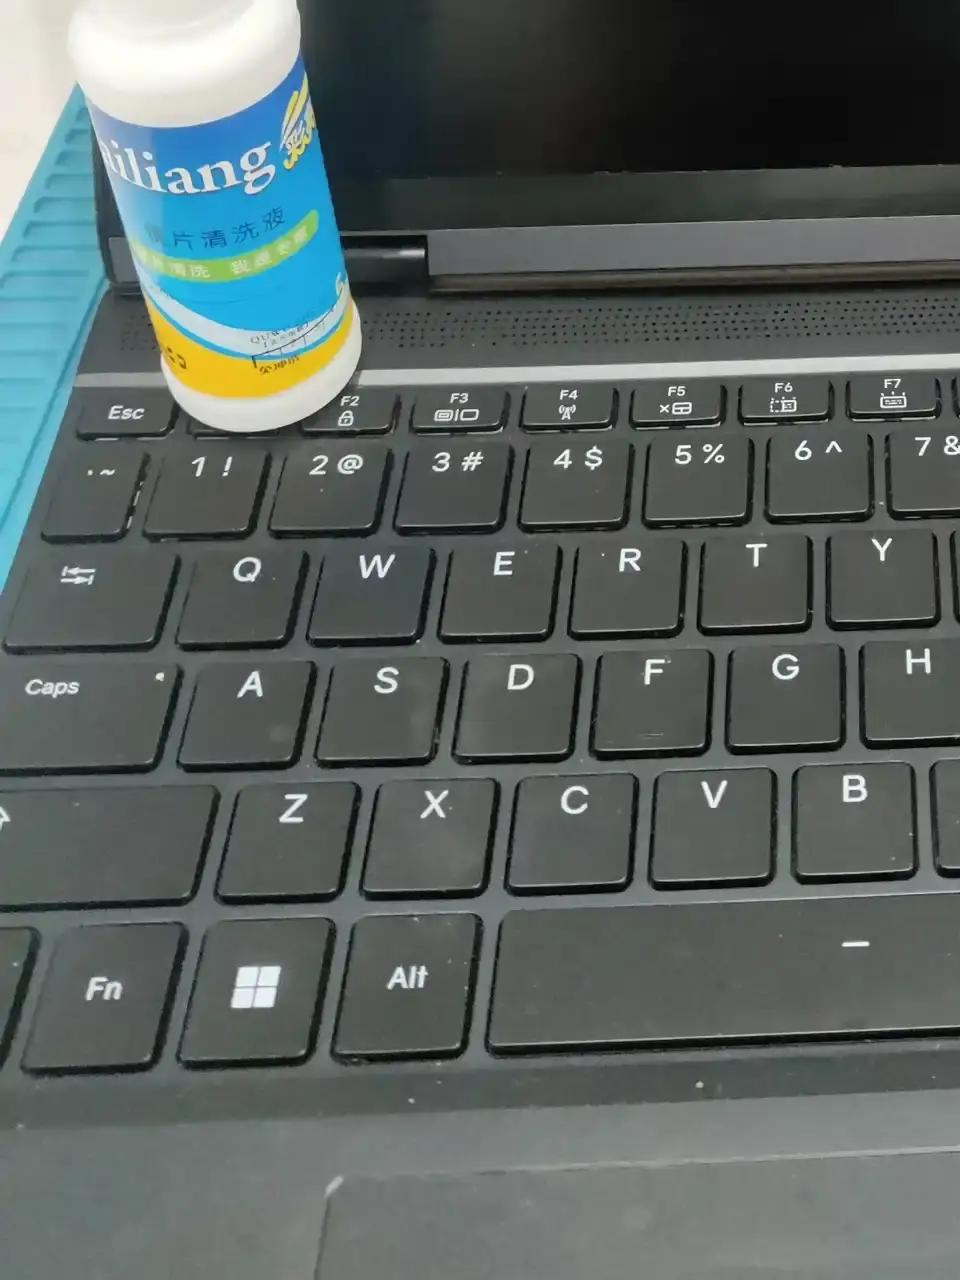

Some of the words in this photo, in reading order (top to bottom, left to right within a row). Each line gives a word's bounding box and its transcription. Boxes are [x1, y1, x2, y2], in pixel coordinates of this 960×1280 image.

[145, 205, 286, 251] 片清洗液
[559, 389, 578, 401] F4
[667, 385, 686, 397] F5
[774, 382, 793, 393] F6
[883, 378, 902, 389] F7
[340, 395, 360, 407] F2
[449, 392, 469, 404] F3
[107, 405, 145, 420] Esc
[553, 448, 573, 469] 4
[674, 444, 692, 465] 5
[794, 439, 813, 461] 6
[914, 436, 932, 457] 7
[191, 456, 206, 477] 1
[309, 454, 329, 475] 2
[431, 451, 451, 472] 3
[619, 548, 642, 572] R
[745, 543, 768, 568] T
[871, 537, 893, 562] Y
[232, 556, 262, 583] Q
[359, 553, 396, 579] W
[493, 551, 516, 576] E
[644, 658, 666, 686] F
[771, 653, 800, 680] G
[905, 648, 932, 675] H
[24, 678, 80, 699] Caps
[237, 670, 264, 698] A
[374, 666, 400, 694] S
[507, 663, 535, 690] D
[560, 785, 589, 815] C
[701, 779, 728, 809] V
[842, 774, 868, 803] B
[278, 793, 308, 824] Z
[420, 789, 449, 819] X
[85, 976, 123, 1001] Fn
[386, 965, 429, 990] Alt
